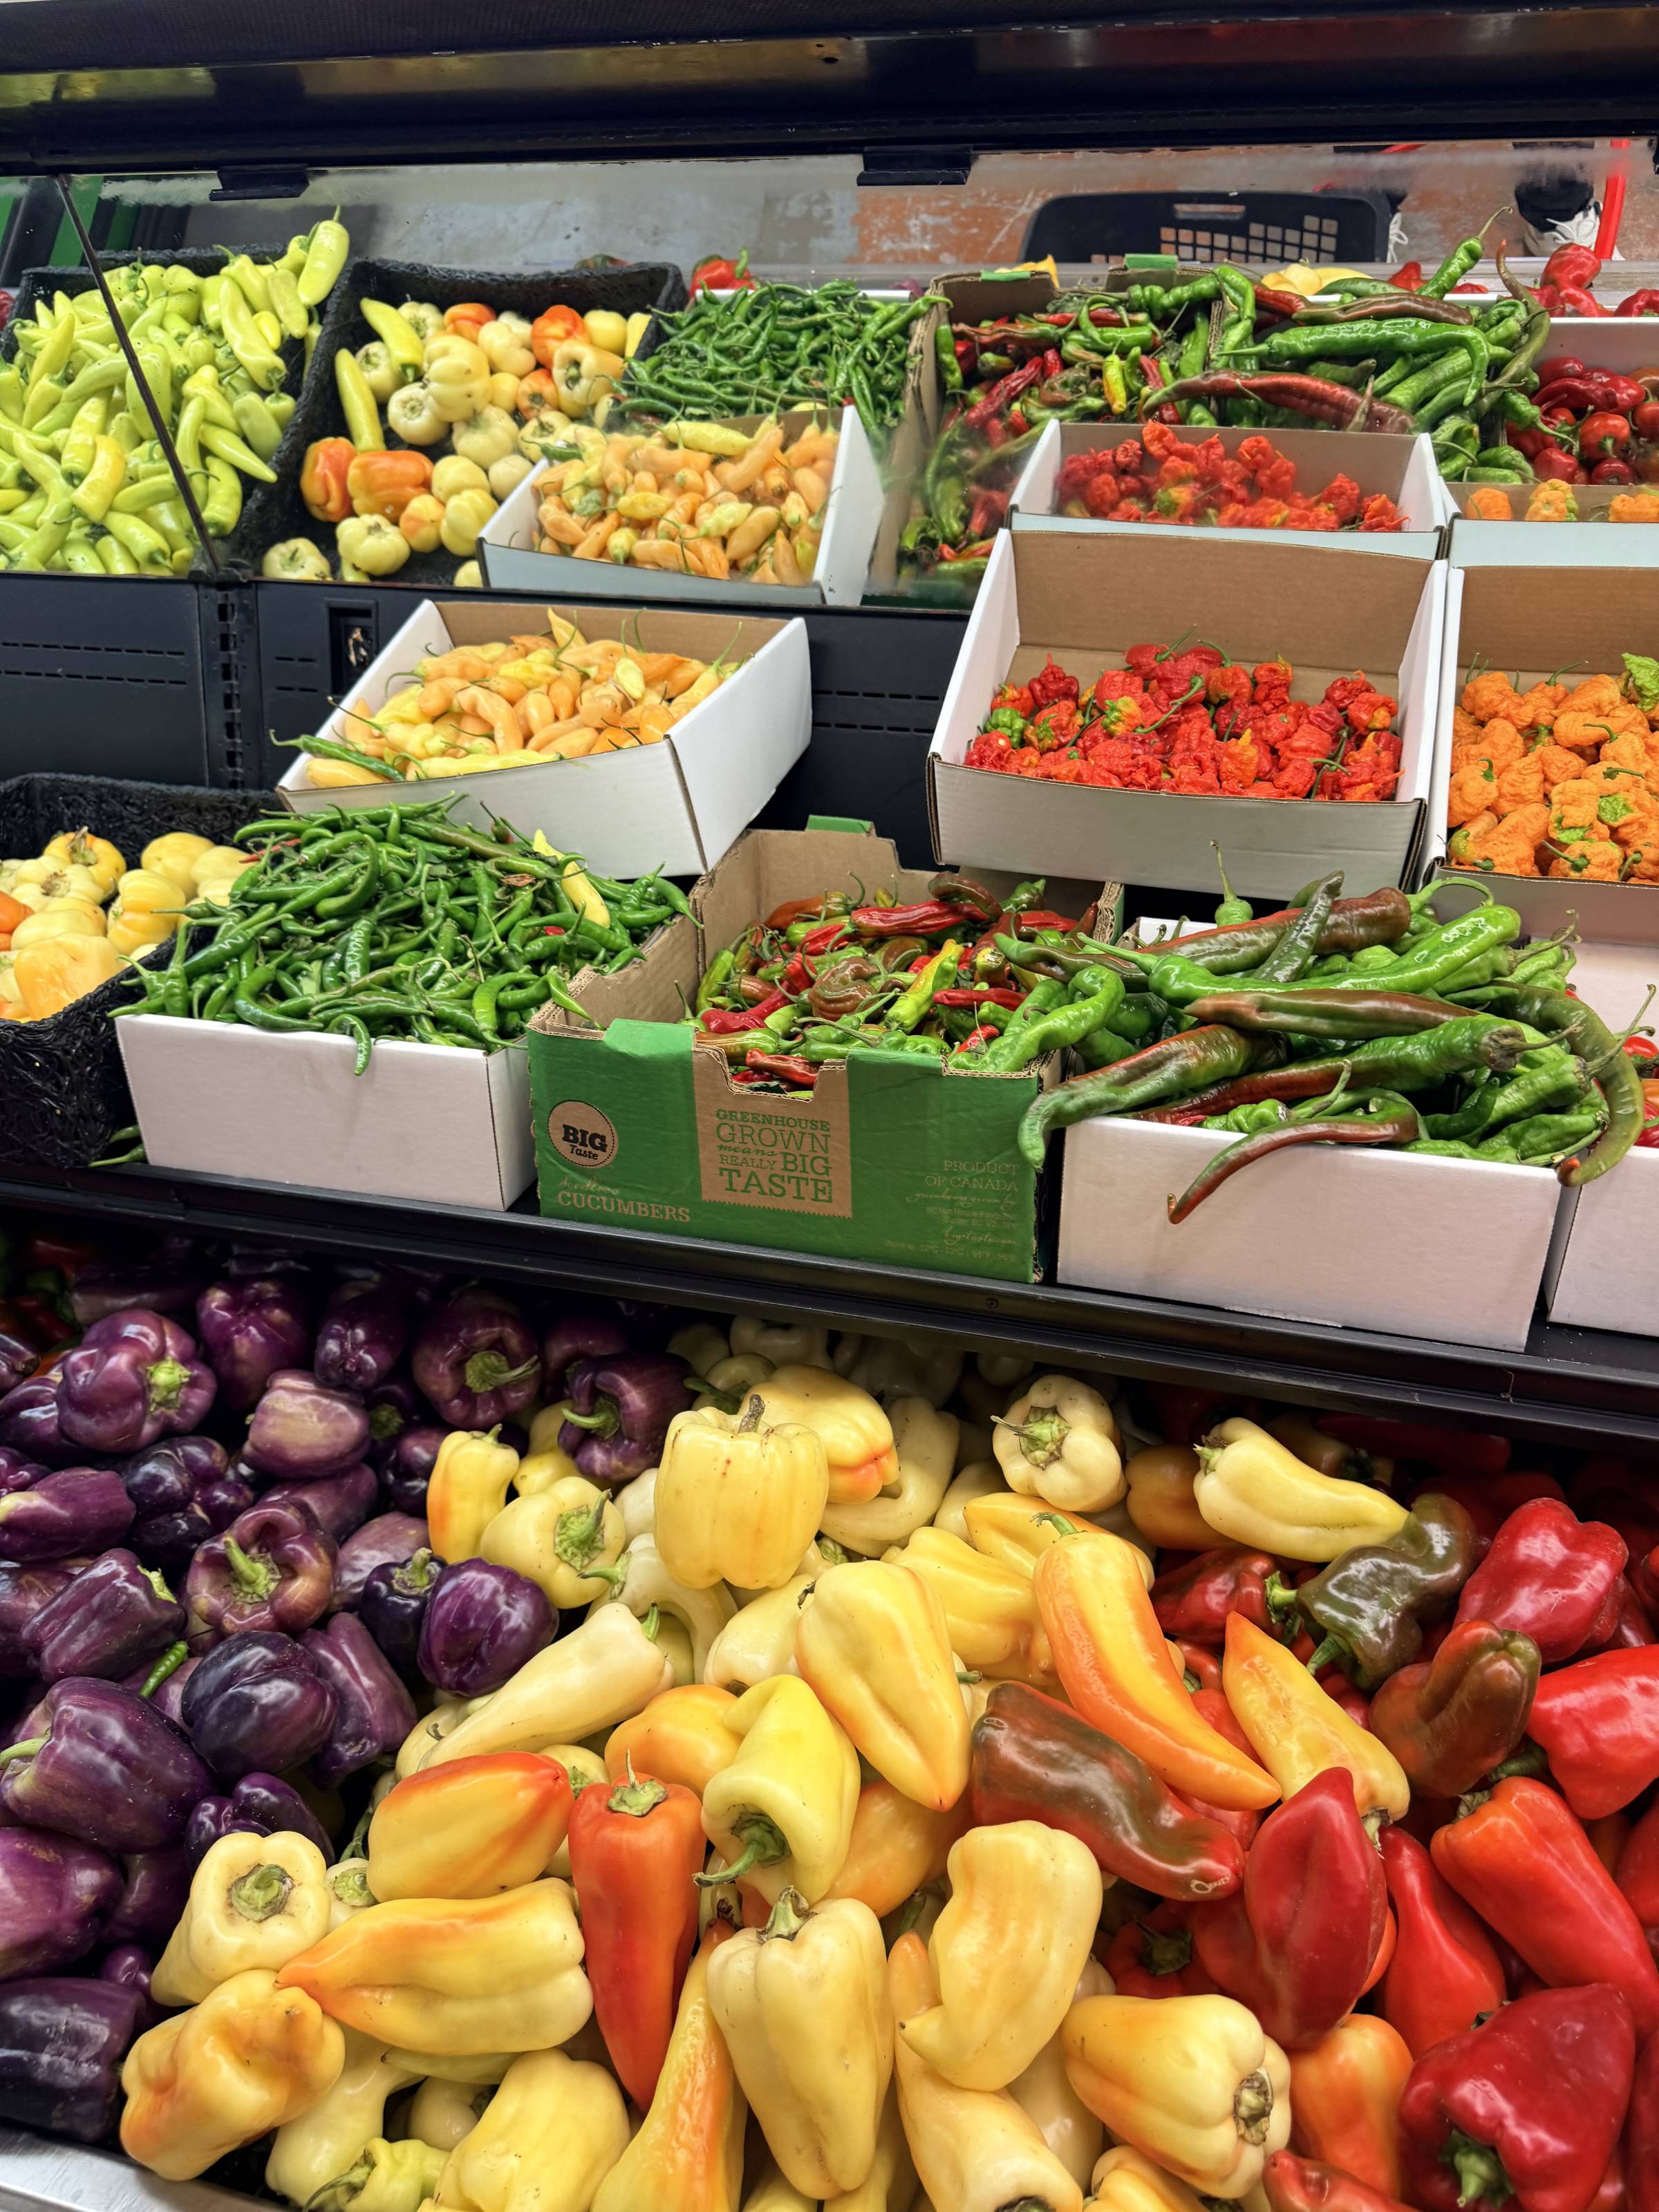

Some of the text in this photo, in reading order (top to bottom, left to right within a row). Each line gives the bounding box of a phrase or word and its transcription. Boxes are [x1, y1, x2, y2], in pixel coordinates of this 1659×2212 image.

[715, 1109, 830, 1132] GREENHOUSE
[562, 1124, 608, 1153] BIG
[716, 1123, 832, 1154] GROWN
[716, 1144, 778, 1156] means
[570, 1144, 599, 1161] Taste
[719, 1152, 833, 1177] REALLY BIG
[944, 1161, 1020, 1175] PRODUCT
[718, 1167, 833, 1204] TASTE
[925, 1175, 1019, 1192] OF CANADA
[557, 1191, 691, 1223] CUCUMBERS
